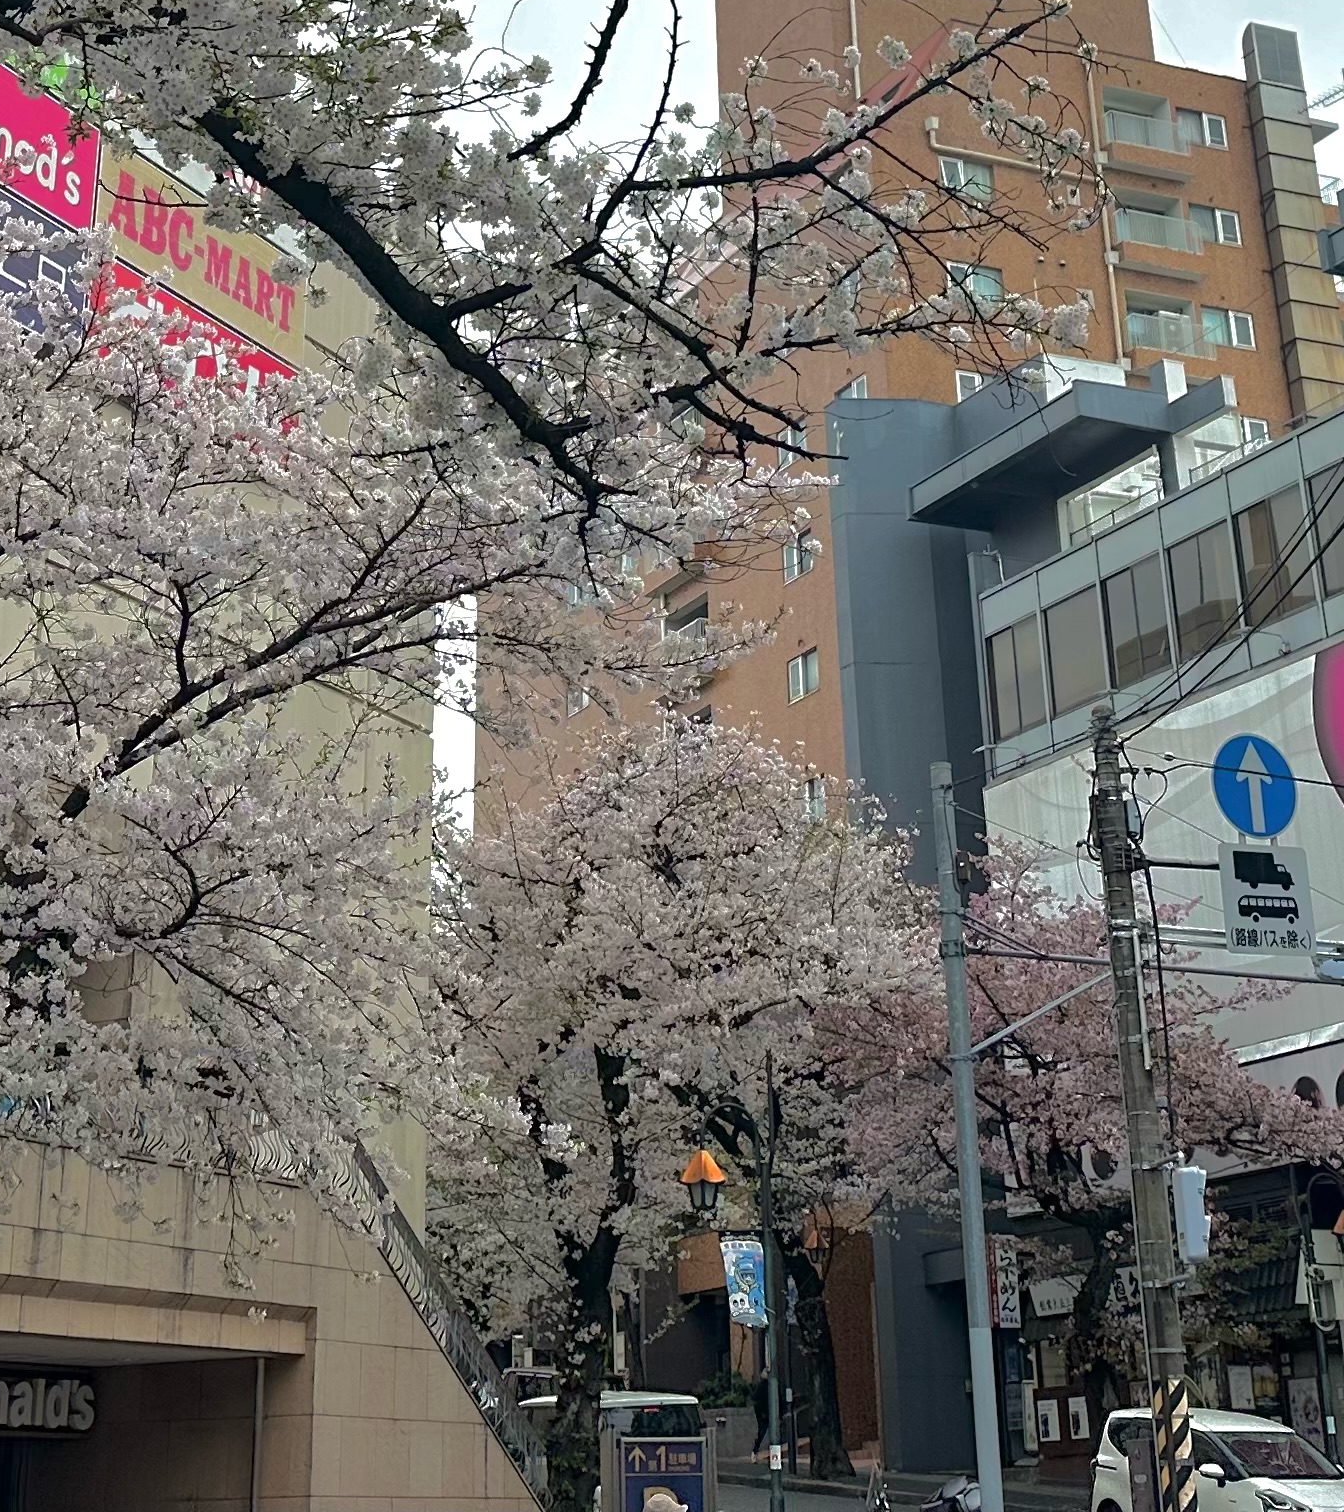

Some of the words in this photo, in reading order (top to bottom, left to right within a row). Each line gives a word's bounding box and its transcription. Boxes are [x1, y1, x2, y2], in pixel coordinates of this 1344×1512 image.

[108, 169, 296, 335] ABC-MART
[1230, 927, 1312, 951] (路線バスを除く)
